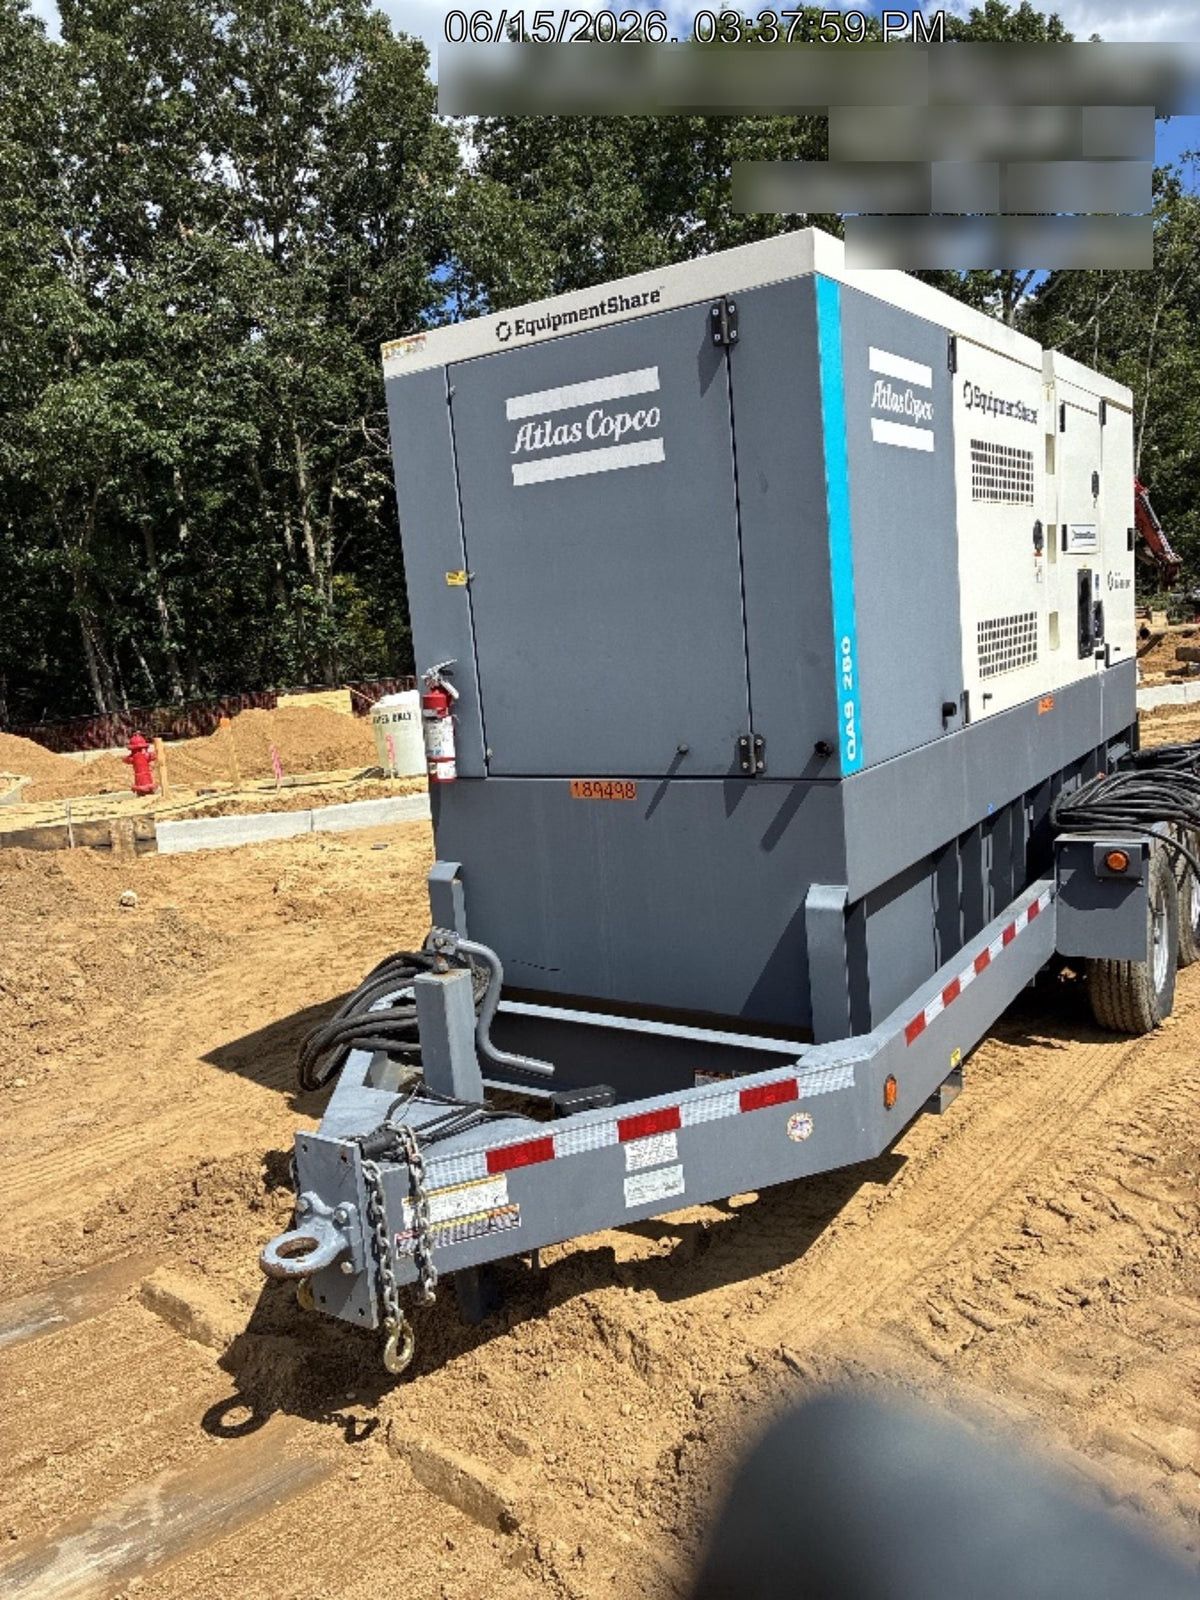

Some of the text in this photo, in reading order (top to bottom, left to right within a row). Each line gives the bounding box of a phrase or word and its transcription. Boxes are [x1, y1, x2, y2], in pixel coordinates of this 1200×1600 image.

[514, 288, 661, 337] EquipmentShare
[870, 379, 904, 414] Atlas
[510, 406, 661, 455] Atlas Copco
[573, 781, 636, 799] 189498
